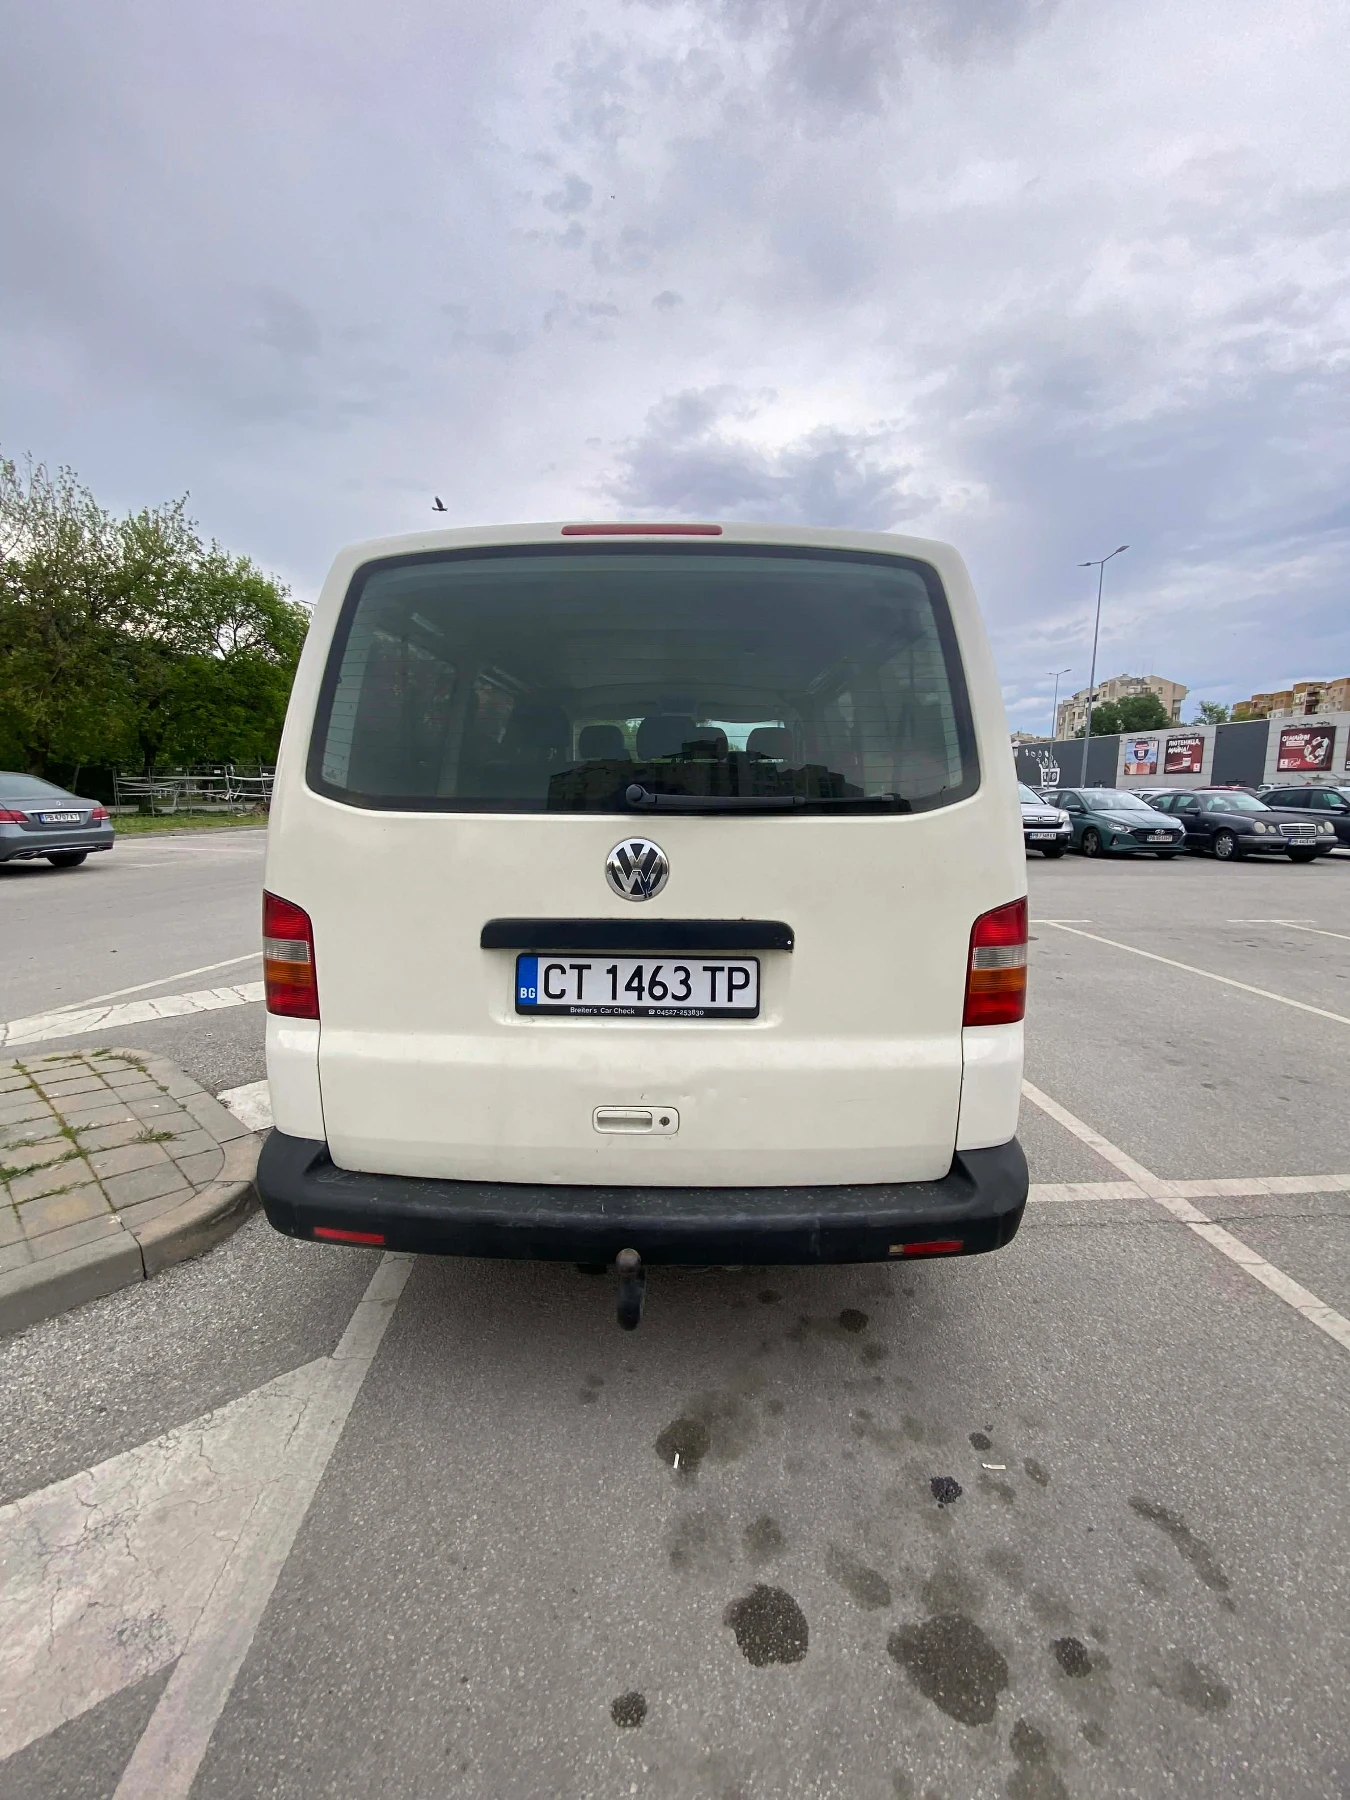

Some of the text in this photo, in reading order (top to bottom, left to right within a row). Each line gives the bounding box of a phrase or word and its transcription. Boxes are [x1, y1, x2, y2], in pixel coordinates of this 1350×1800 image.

[543, 963, 750, 1002] CT 1463 TP
[520, 987, 536, 999] BG
[613, 1007, 635, 1015] Check
